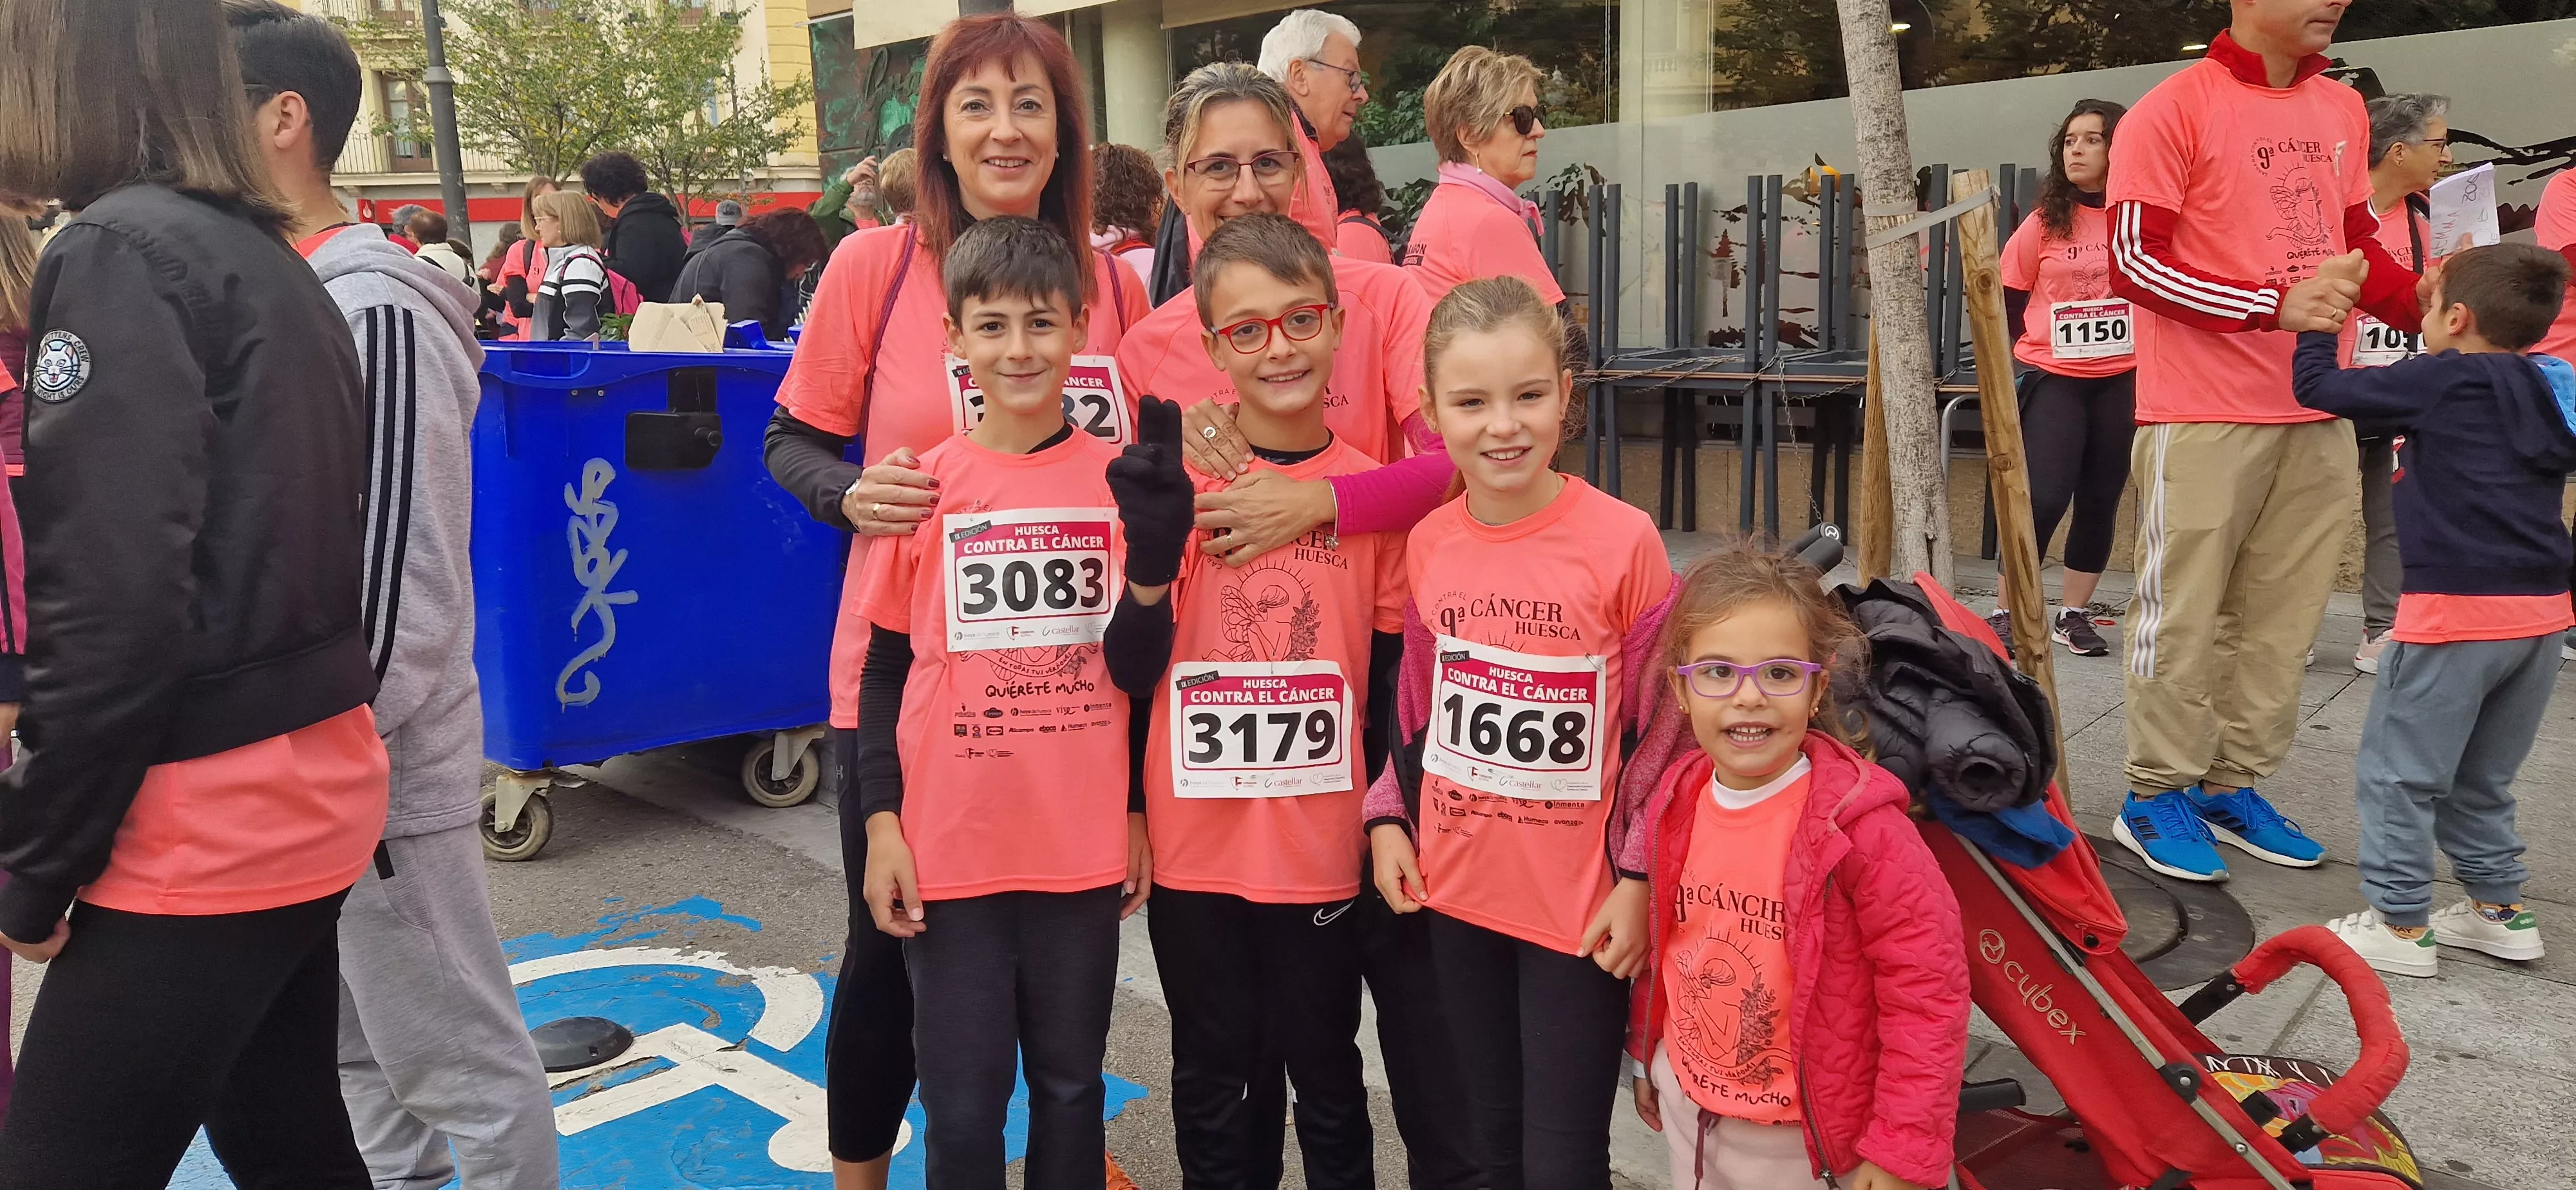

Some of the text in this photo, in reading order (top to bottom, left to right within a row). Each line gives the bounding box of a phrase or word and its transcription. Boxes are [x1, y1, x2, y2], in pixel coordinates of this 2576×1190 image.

[2257, 147, 2275, 169] 9ª
[2085, 242, 2108, 252] CÁN
[2059, 319, 2126, 344] 1150
[73, 341, 90, 363] CREW
[66, 375, 84, 395] OURS
[961, 524, 988, 538] EDICIÓN
[1015, 525, 1059, 536] HUESCA
[963, 533, 1104, 554] CONTRA EL CÁNCER
[1294, 547, 1349, 570] HUESCA
[962, 558, 1104, 615] 3083
[1470, 592, 1563, 623] CÁNCER
[1052, 625, 1079, 635] castellar
[1515, 621, 1581, 641] HUESCA
[1188, 674, 1215, 686] EDICIÓN
[1243, 679, 1287, 688] HUESCA
[1448, 667, 1588, 701] CONTRA EL CÁNCER
[1489, 666, 1533, 684] HUESCA
[1055, 679, 1095, 695] MUCHO
[1190, 687, 1335, 703] CONTRA EL CÁNCER
[1188, 709, 1336, 764] 3179
[1443, 693, 1586, 764] 1668
[1274, 777, 1302, 786] castellar
[1509, 779, 1542, 789] castellar
[1740, 917, 1787, 941] HUES
[2004, 961, 2087, 1045] cybex
[1735, 1092, 1791, 1108] MUCHO
